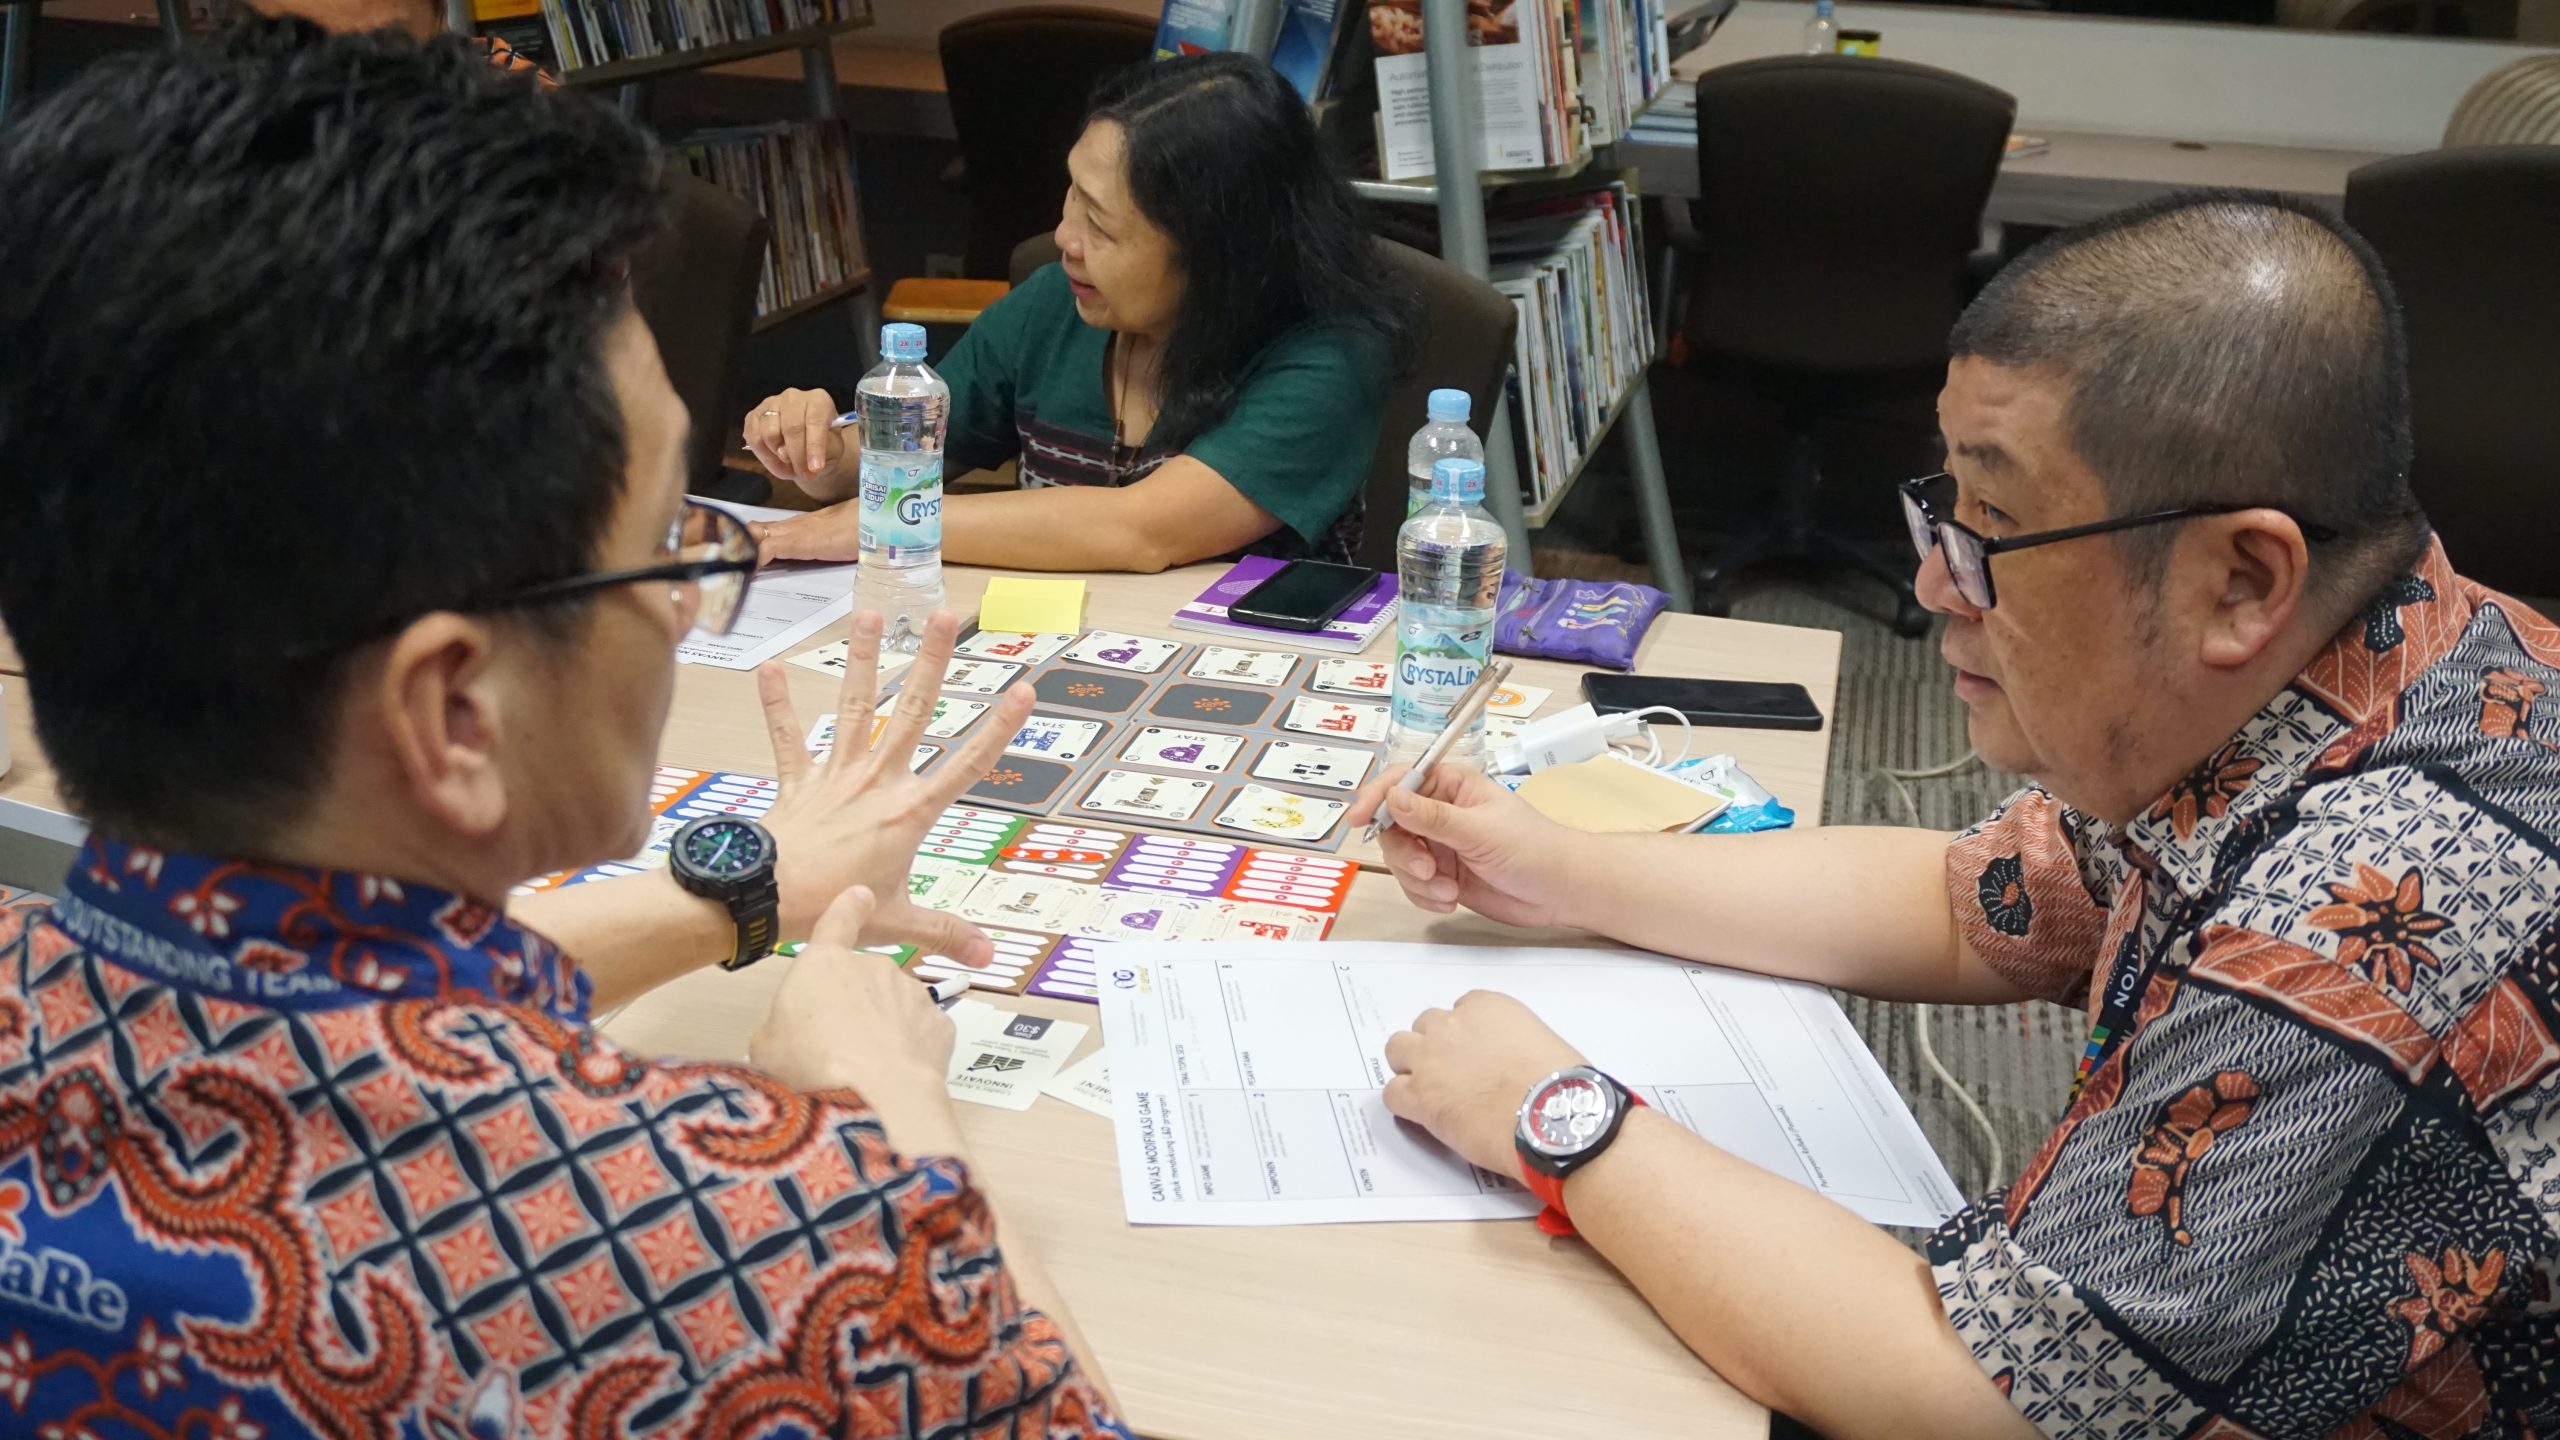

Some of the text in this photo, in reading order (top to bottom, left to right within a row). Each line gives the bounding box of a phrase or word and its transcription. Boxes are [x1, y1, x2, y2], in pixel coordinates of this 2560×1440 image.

[691, 652, 734, 662] CANVAS
[1032, 721, 1066, 729] STAY
[1173, 734, 1209, 742] STAY
[1014, 1023, 1041, 1035] $30
[1370, 1058, 1386, 1086] MODIFIKASI
[956, 1074, 1014, 1089] INNOVATE
[1160, 1126, 1172, 1140] L&D
[1136, 1092, 1165, 1202] CANVAS MODIFIKASI GAME
[1166, 1140, 1178, 1179] mendukung
[1200, 1164, 1212, 1181] GAME
[1266, 1162, 1281, 1194] KOMPONEN
[1360, 1168, 1373, 1192] KONTEN
